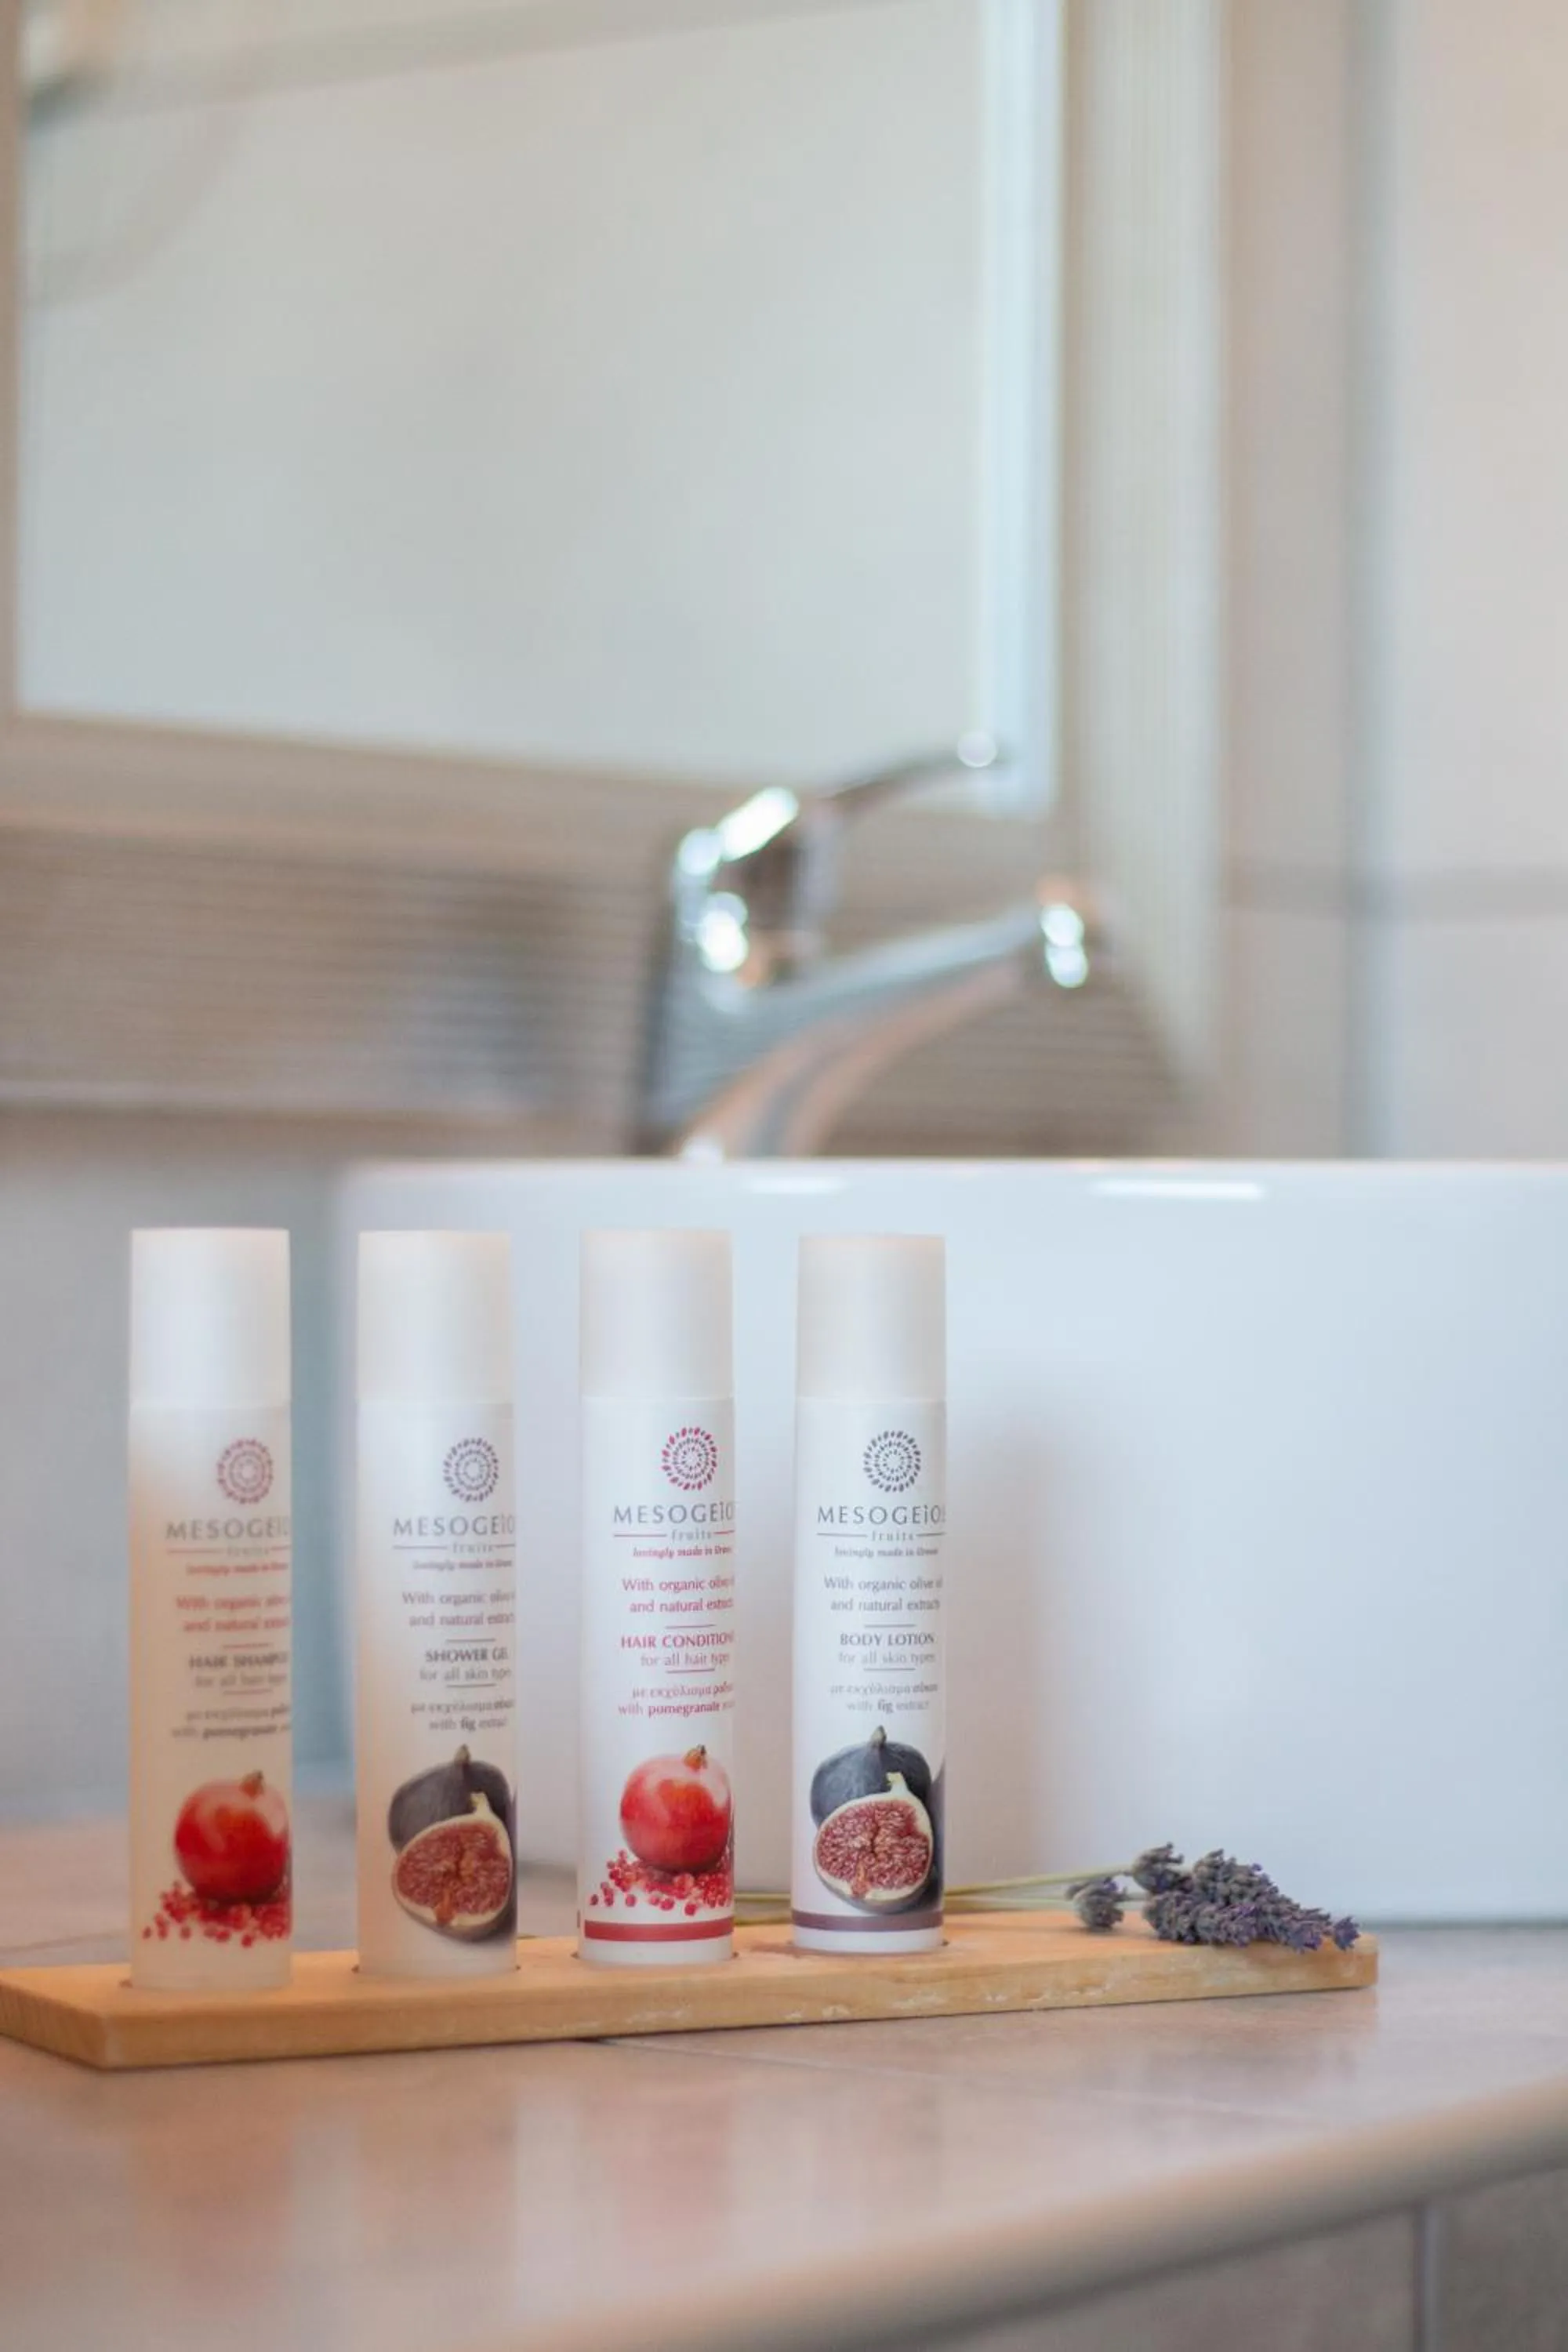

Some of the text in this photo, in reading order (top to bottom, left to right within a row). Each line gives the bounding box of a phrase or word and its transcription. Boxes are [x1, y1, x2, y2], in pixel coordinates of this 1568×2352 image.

[622, 1577, 654, 1591] With
[659, 1577, 705, 1593] organic
[824, 1577, 853, 1590] With
[858, 1577, 907, 1592] organic
[402, 1592, 434, 1604] With
[830, 1599, 853, 1611] and
[858, 1598, 903, 1611] natural
[630, 1600, 655, 1613] and
[659, 1598, 703, 1612] natural
[409, 1612, 435, 1626] and
[440, 1612, 484, 1626] natural
[621, 1635, 656, 1648] HAIR
[840, 1632, 935, 1646] BODY LOTION
[425, 1647, 488, 1662] SHOWER
[641, 1654, 659, 1666] for
[665, 1653, 680, 1666] all
[685, 1653, 706, 1664] hair
[877, 1699, 894, 1714] fig
